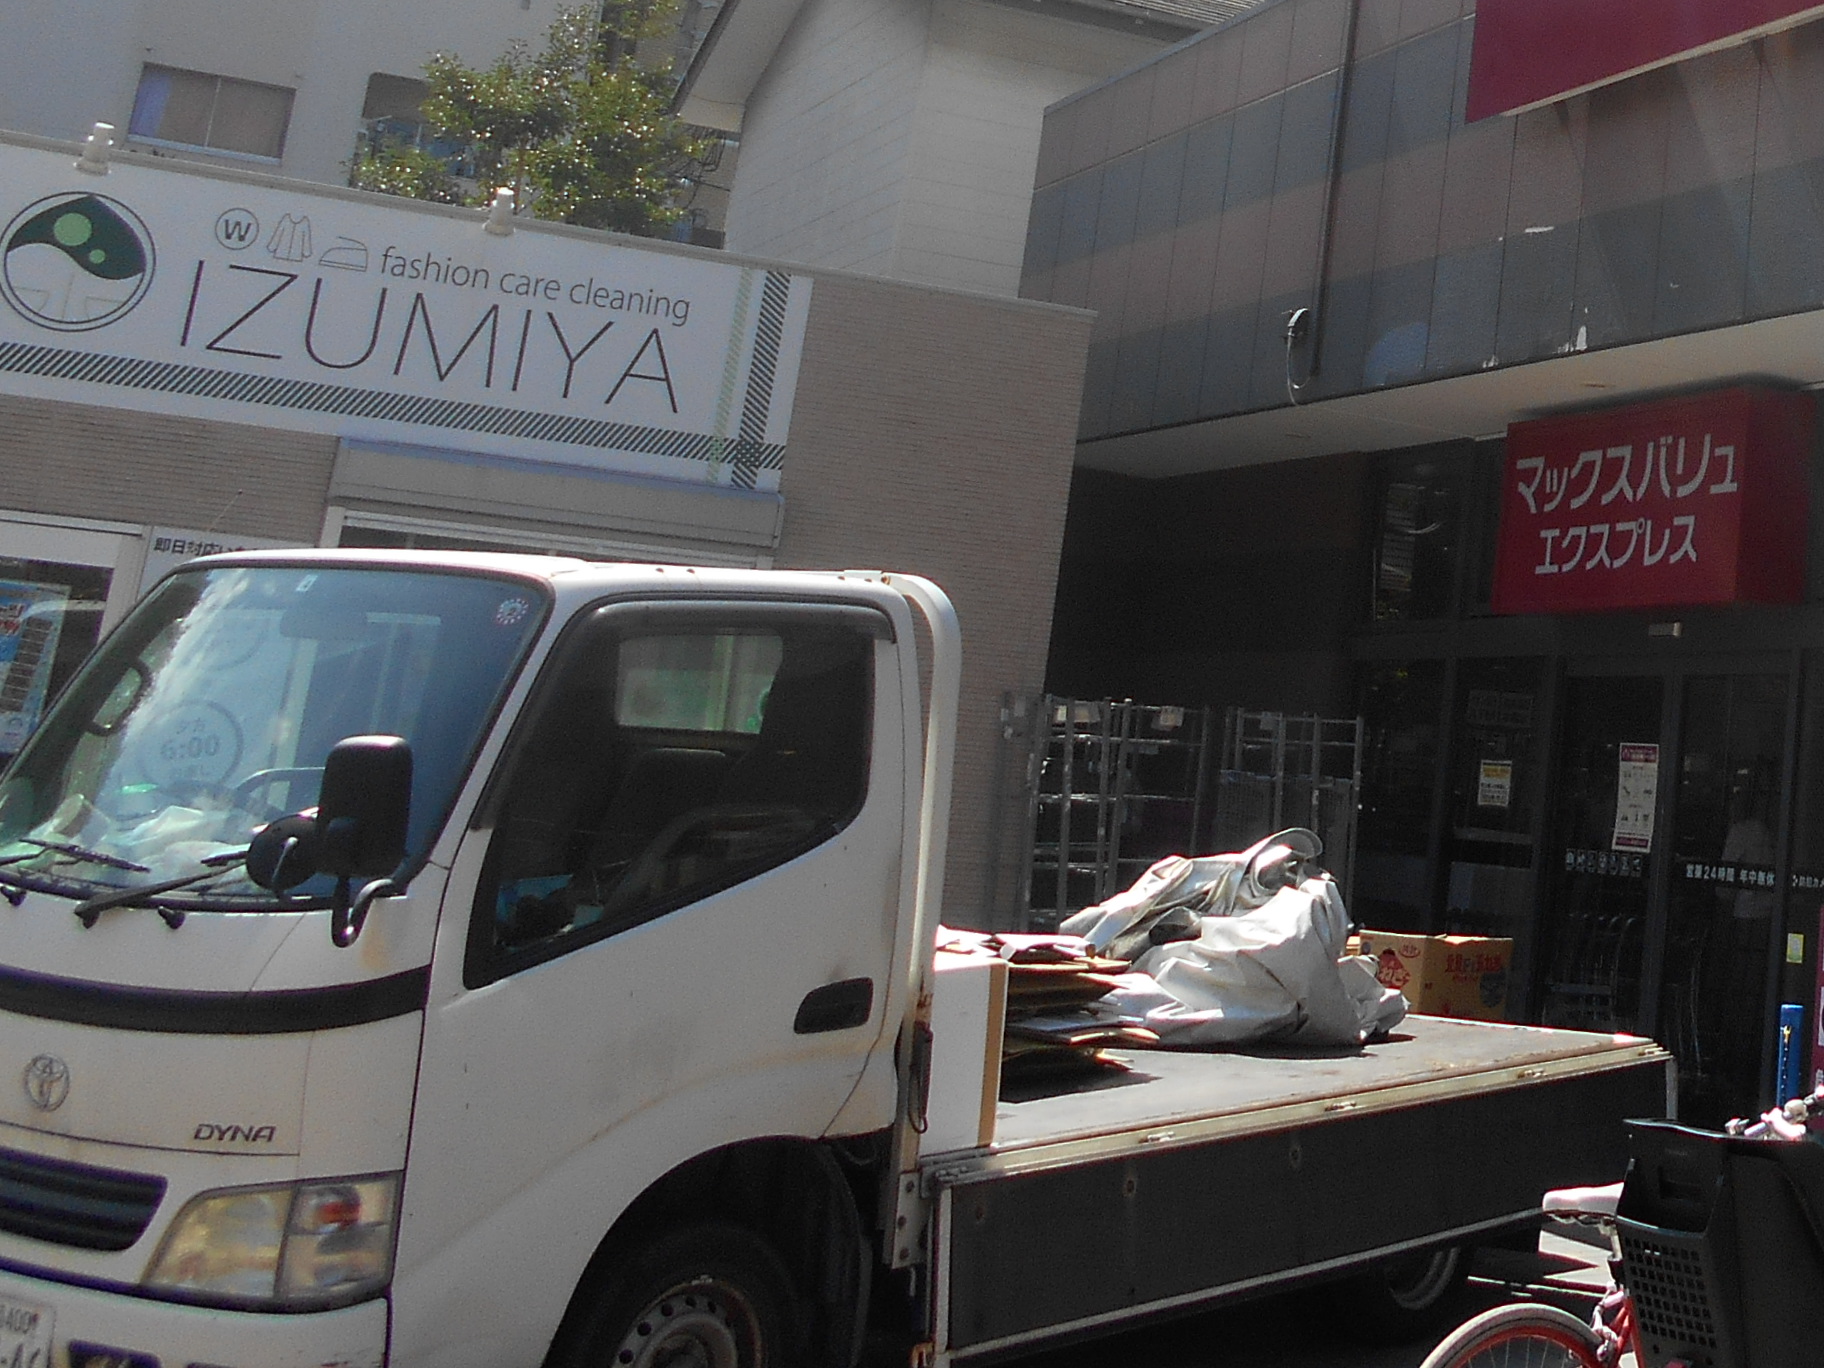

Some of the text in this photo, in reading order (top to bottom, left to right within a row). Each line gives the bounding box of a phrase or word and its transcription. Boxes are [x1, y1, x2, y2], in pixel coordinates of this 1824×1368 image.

[380, 245, 691, 328] fashion care cleaning
[180, 258, 678, 414] IZUMIYA
[1515, 434, 1738, 516] マックスバリュ
[1534, 516, 1698, 576] エクスプレス
[193, 1123, 277, 1143] DYNA
